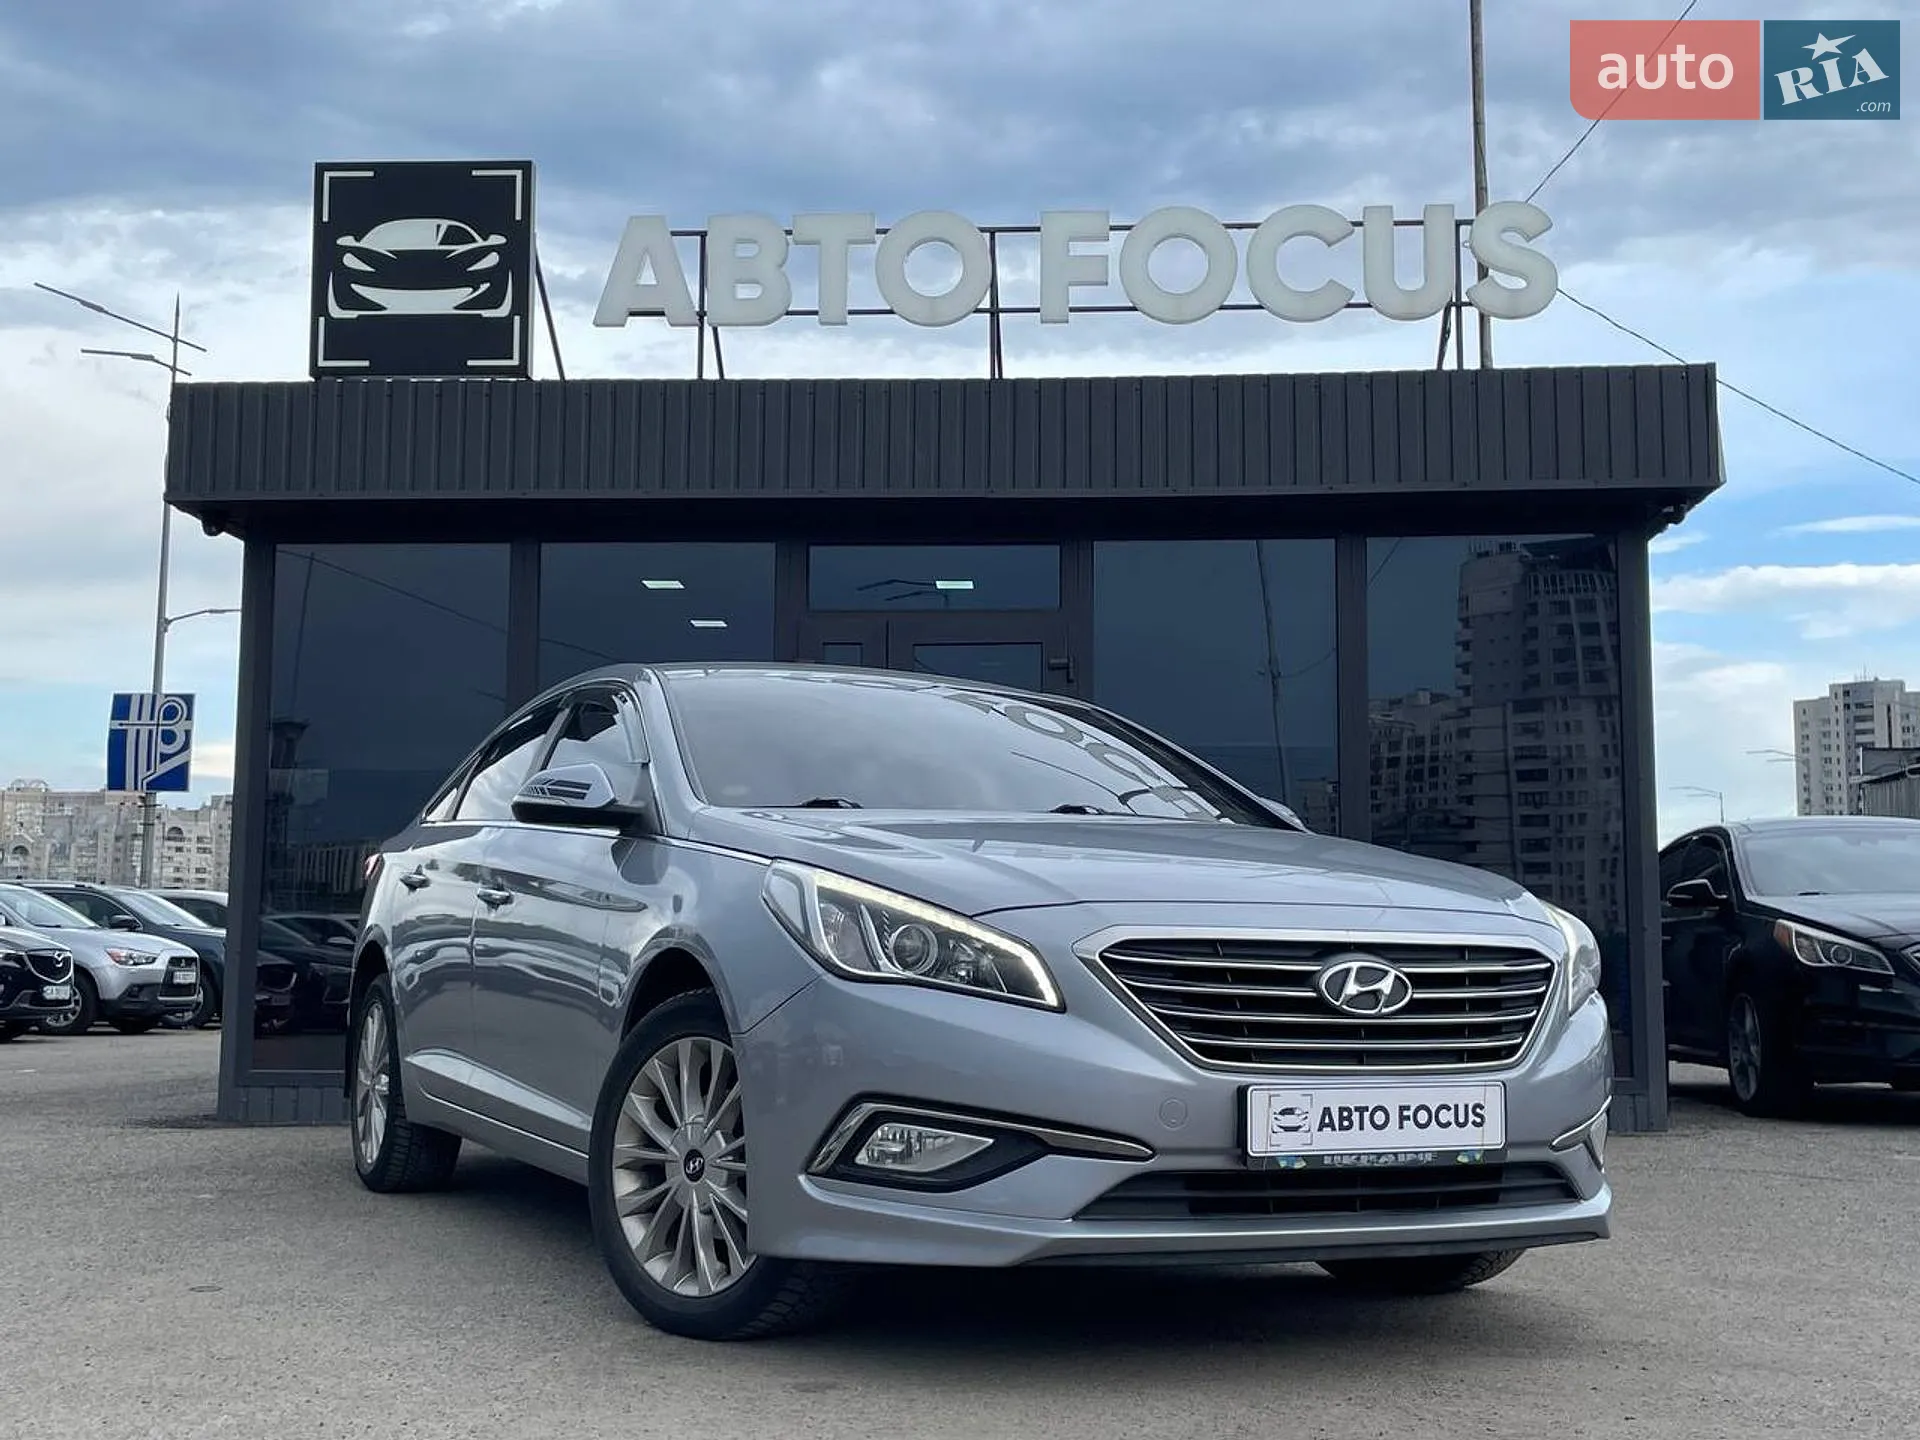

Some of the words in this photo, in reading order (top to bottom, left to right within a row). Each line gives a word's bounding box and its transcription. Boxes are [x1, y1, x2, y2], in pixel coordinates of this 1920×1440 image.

[593, 210, 992, 328] АВТО
[1038, 200, 1559, 325] FOCUS
[1316, 1105, 1391, 1133] АВТО
[1398, 1102, 1487, 1131] FOCUS
